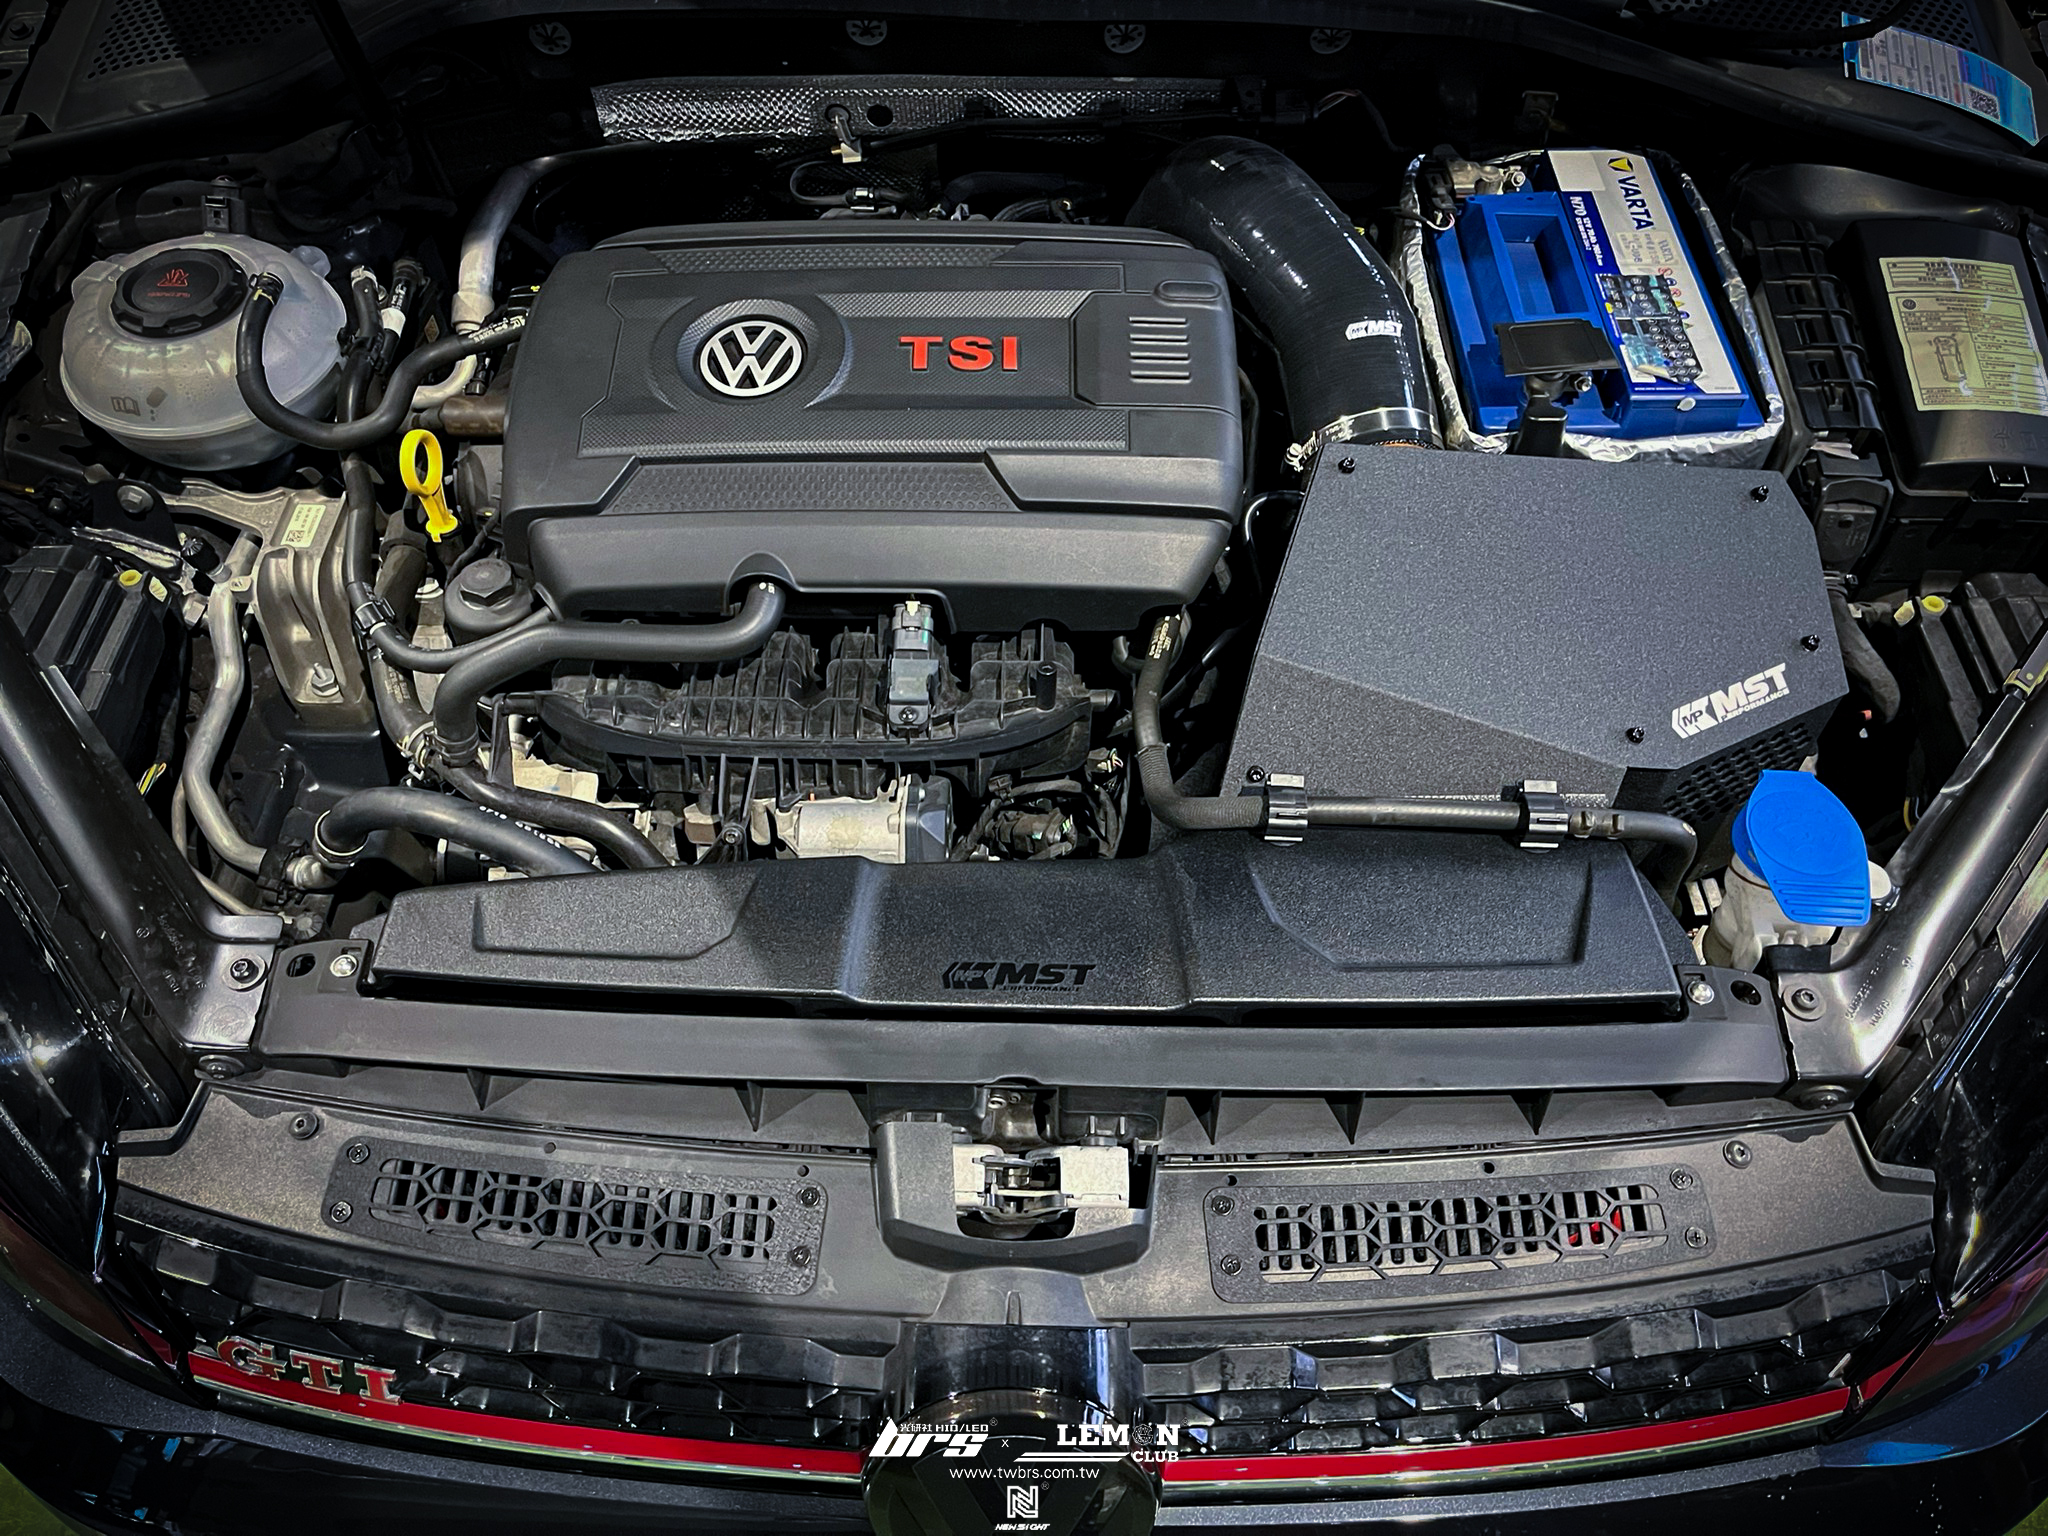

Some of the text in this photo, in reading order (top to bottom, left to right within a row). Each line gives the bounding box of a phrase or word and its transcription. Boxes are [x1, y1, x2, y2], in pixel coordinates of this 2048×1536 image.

[1570, 196, 1587, 216] N70
[1618, 176, 1655, 230] VARTA
[899, 336, 1018, 371] TSI
[1709, 662, 1787, 723] MST
[1719, 687, 1790, 722] PERFORMANCE
[993, 963, 1097, 989] MST
[217, 1336, 401, 1405] GTI
